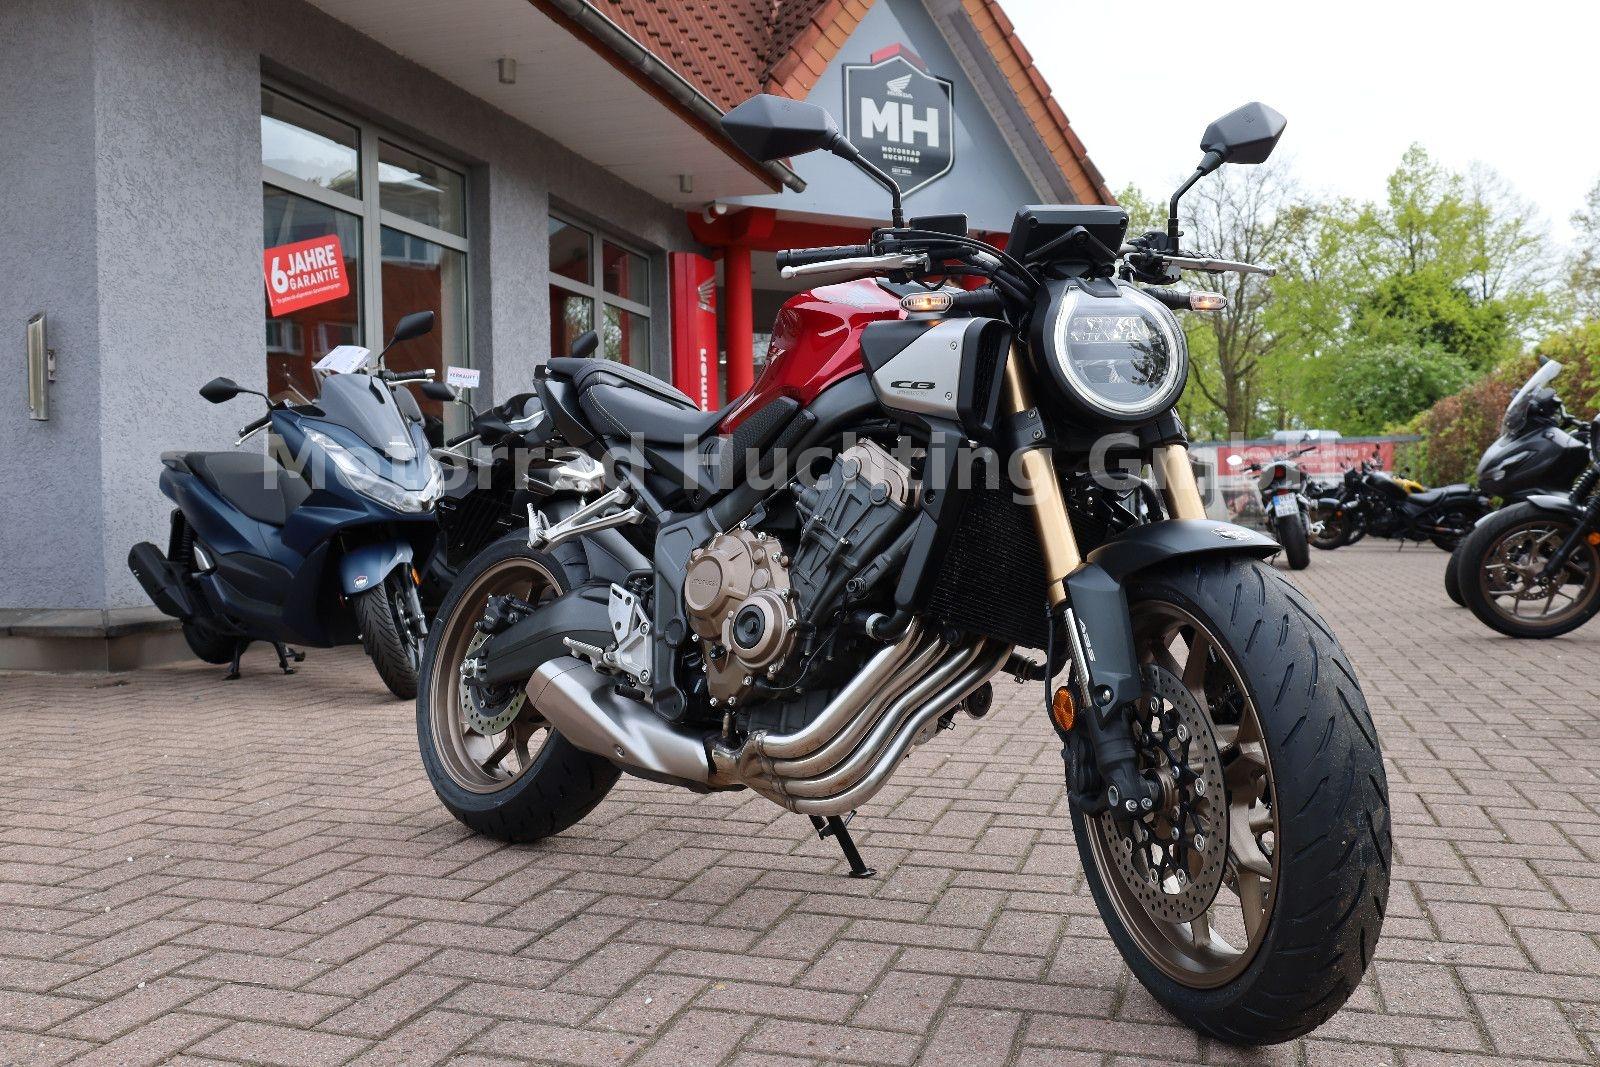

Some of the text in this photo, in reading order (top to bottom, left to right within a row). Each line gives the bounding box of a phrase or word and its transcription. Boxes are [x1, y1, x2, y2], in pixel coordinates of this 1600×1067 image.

[861, 97, 939, 148] MH
[881, 146, 921, 157] MOTORRAD
[882, 153, 920, 163] HUCHTING
[271, 256, 289, 294] 6
[289, 267, 340, 290] GARANTIE
[891, 380, 936, 389] CB
[1079, 617, 1096, 662] ABS
